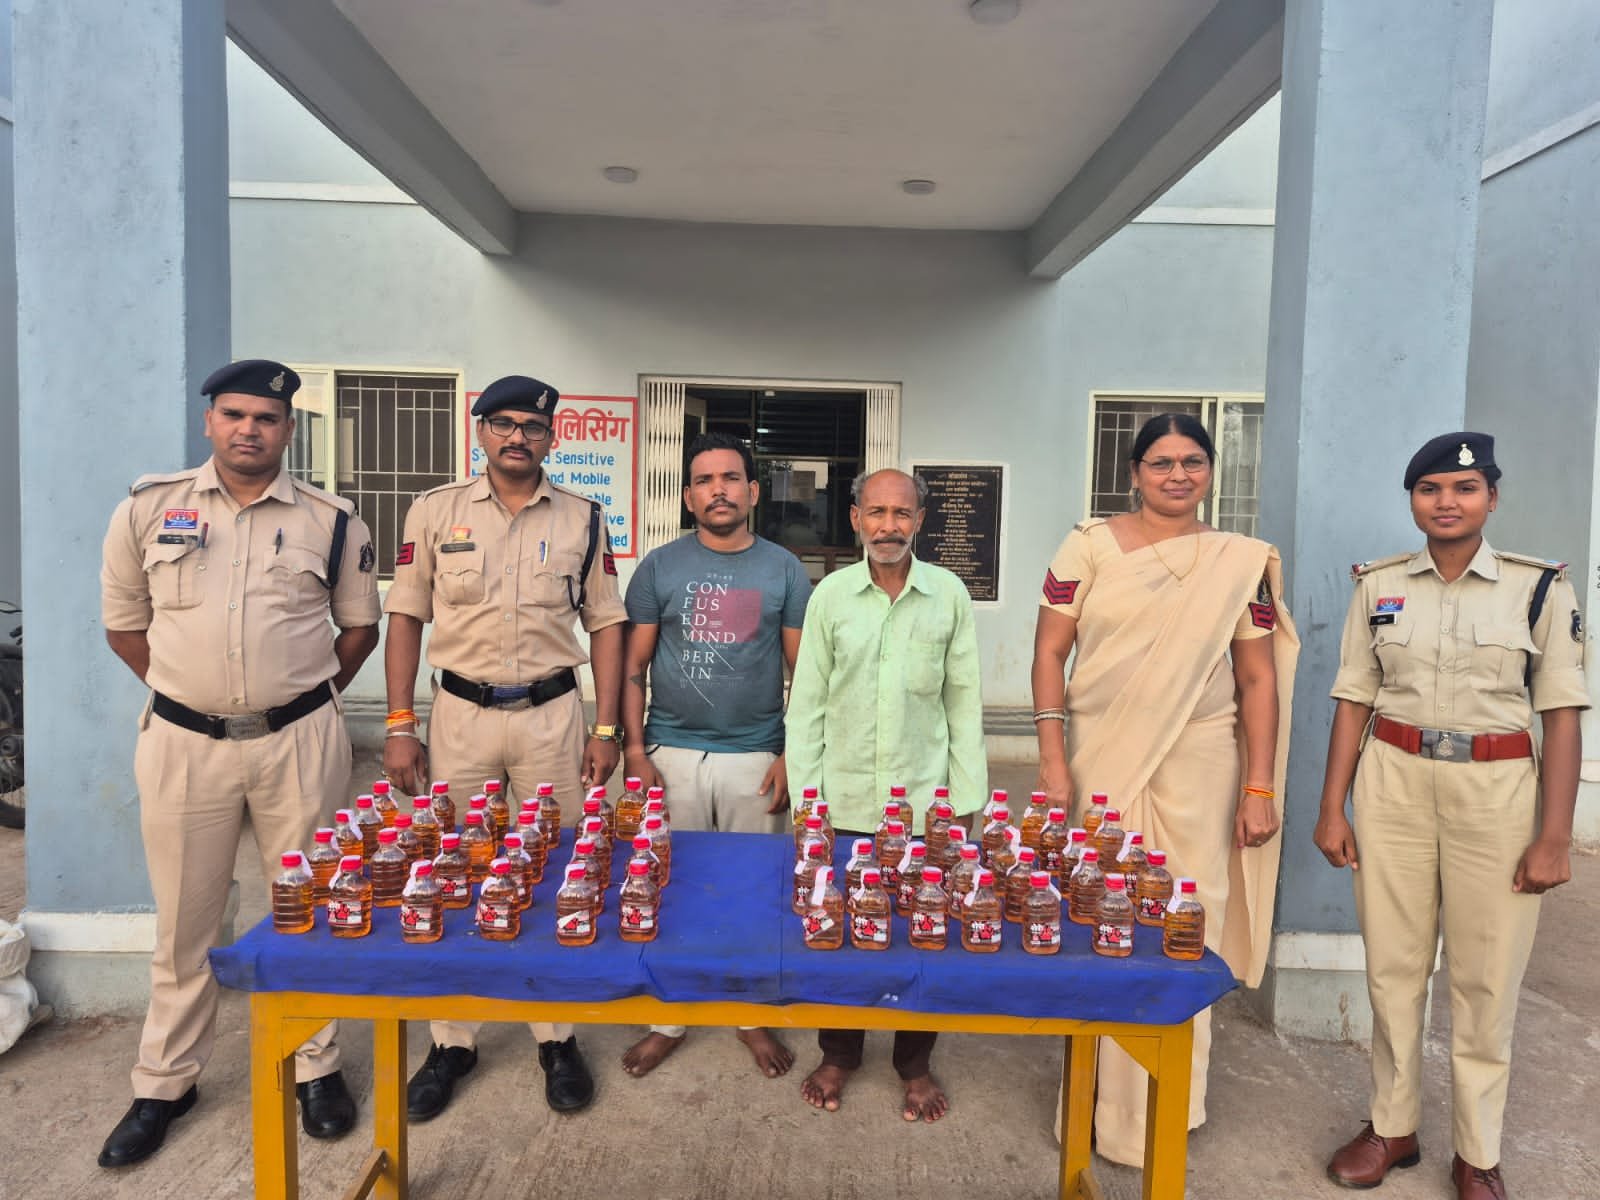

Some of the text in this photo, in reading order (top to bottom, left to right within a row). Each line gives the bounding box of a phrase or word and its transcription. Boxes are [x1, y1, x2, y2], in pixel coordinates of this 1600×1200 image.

[555, 451, 615, 466] Sensitive
[548, 471, 611, 485] nd Mobile
[686, 580, 728, 596] CON
[682, 596, 720, 611] FUS
[682, 629, 736, 644] MIND
[682, 649, 715, 664] BER
